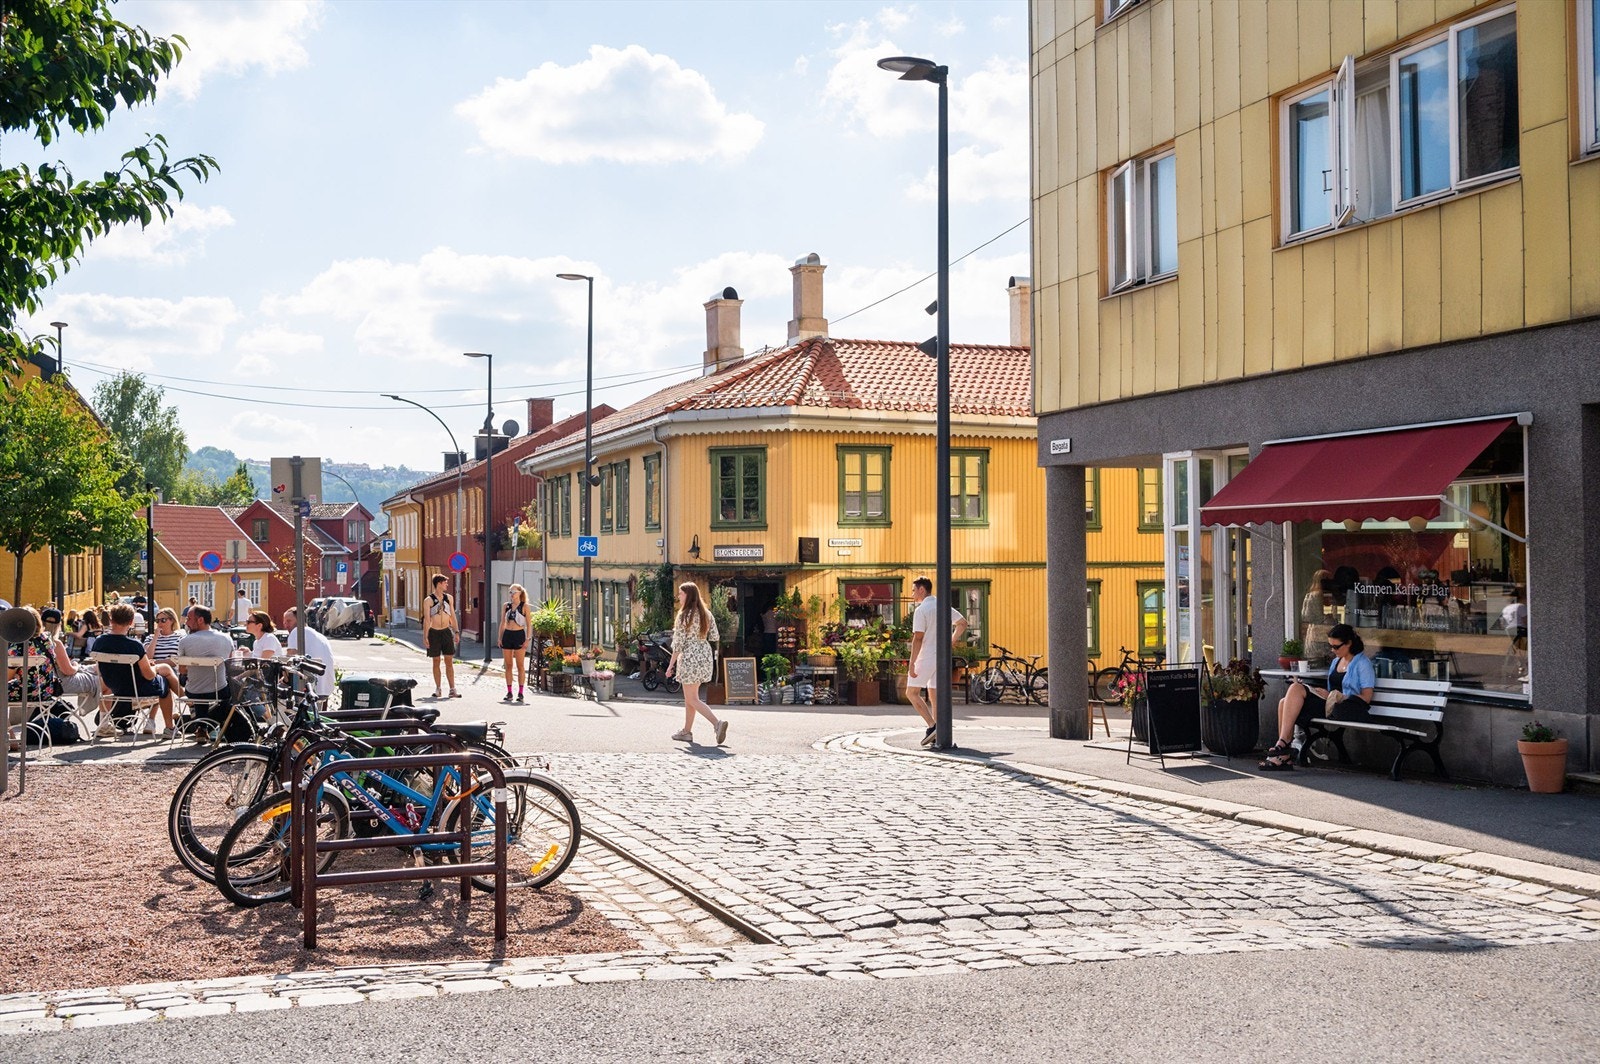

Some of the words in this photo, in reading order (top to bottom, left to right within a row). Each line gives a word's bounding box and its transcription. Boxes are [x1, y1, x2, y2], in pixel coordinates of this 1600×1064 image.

[385, 541, 393, 551] P
[1354, 583, 1393, 596] Kampen
[1394, 583, 1420, 595] Kaffe
[1421, 584, 1430, 596] &
[1432, 584, 1450, 596] Bar
